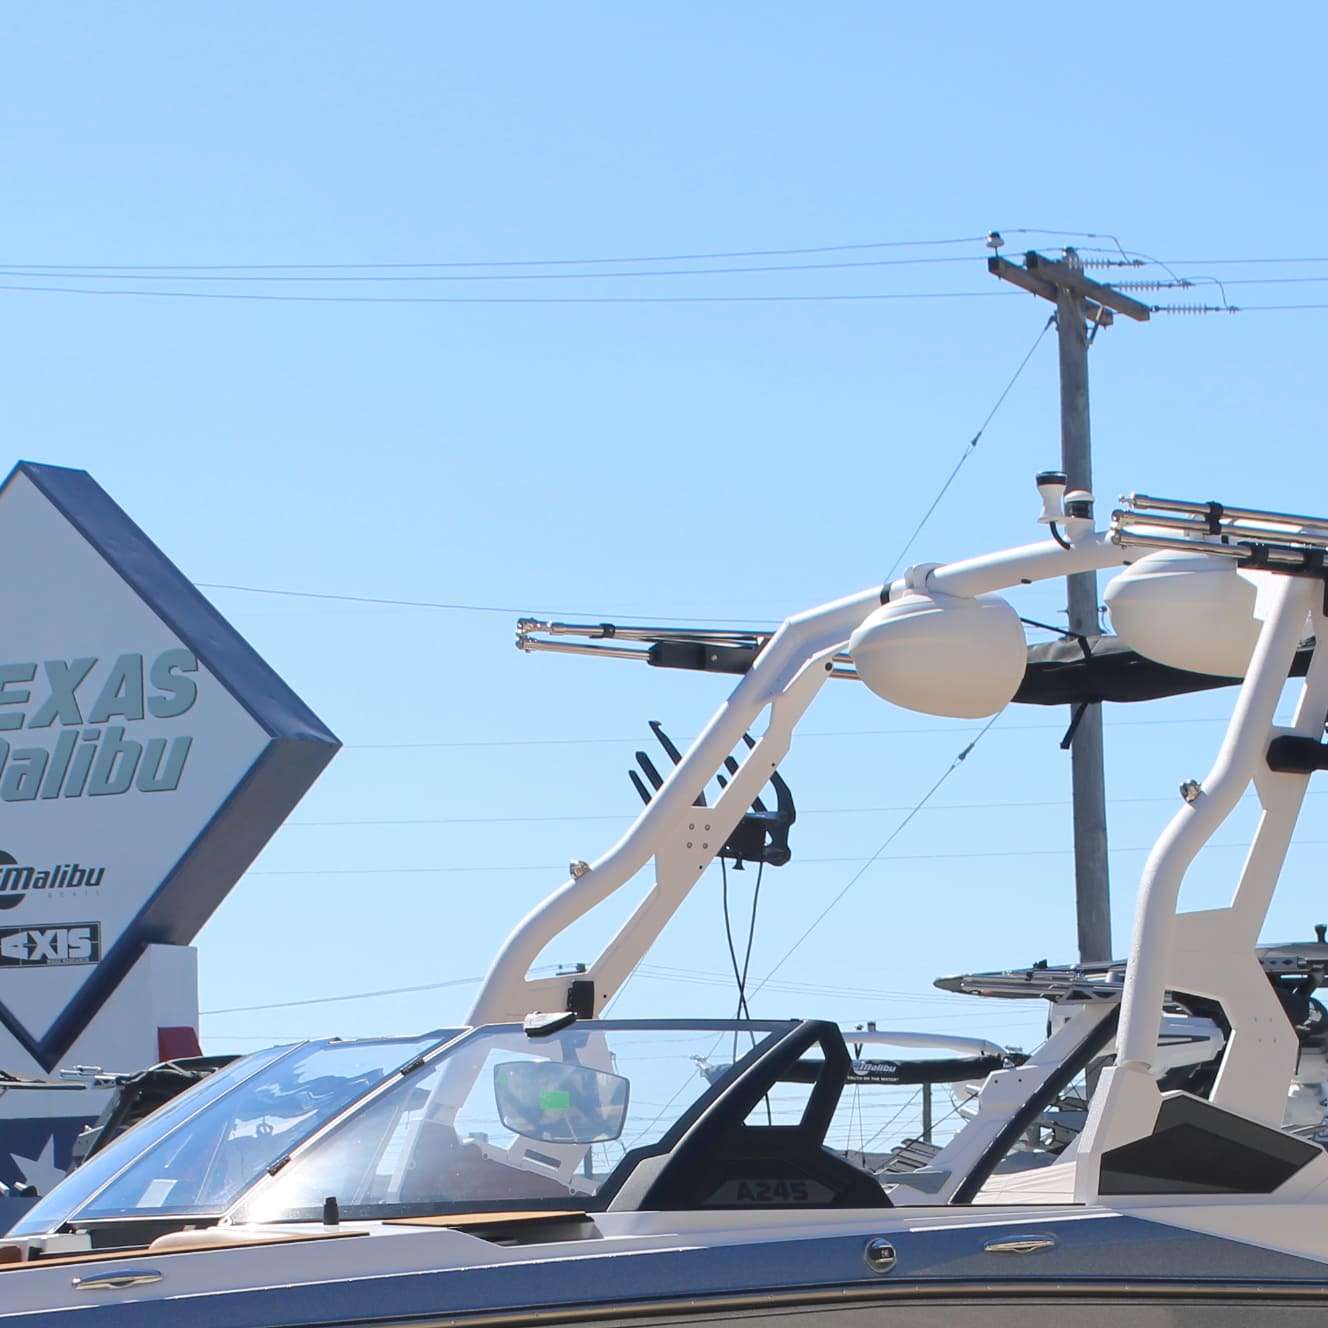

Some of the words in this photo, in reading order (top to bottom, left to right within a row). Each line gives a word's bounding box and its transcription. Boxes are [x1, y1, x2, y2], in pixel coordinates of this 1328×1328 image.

[0, 863, 106, 891] Malibu
[0, 928, 92, 960] AXIS
[859, 1062, 897, 1073] Malibu
[736, 1181, 809, 1202] A245
